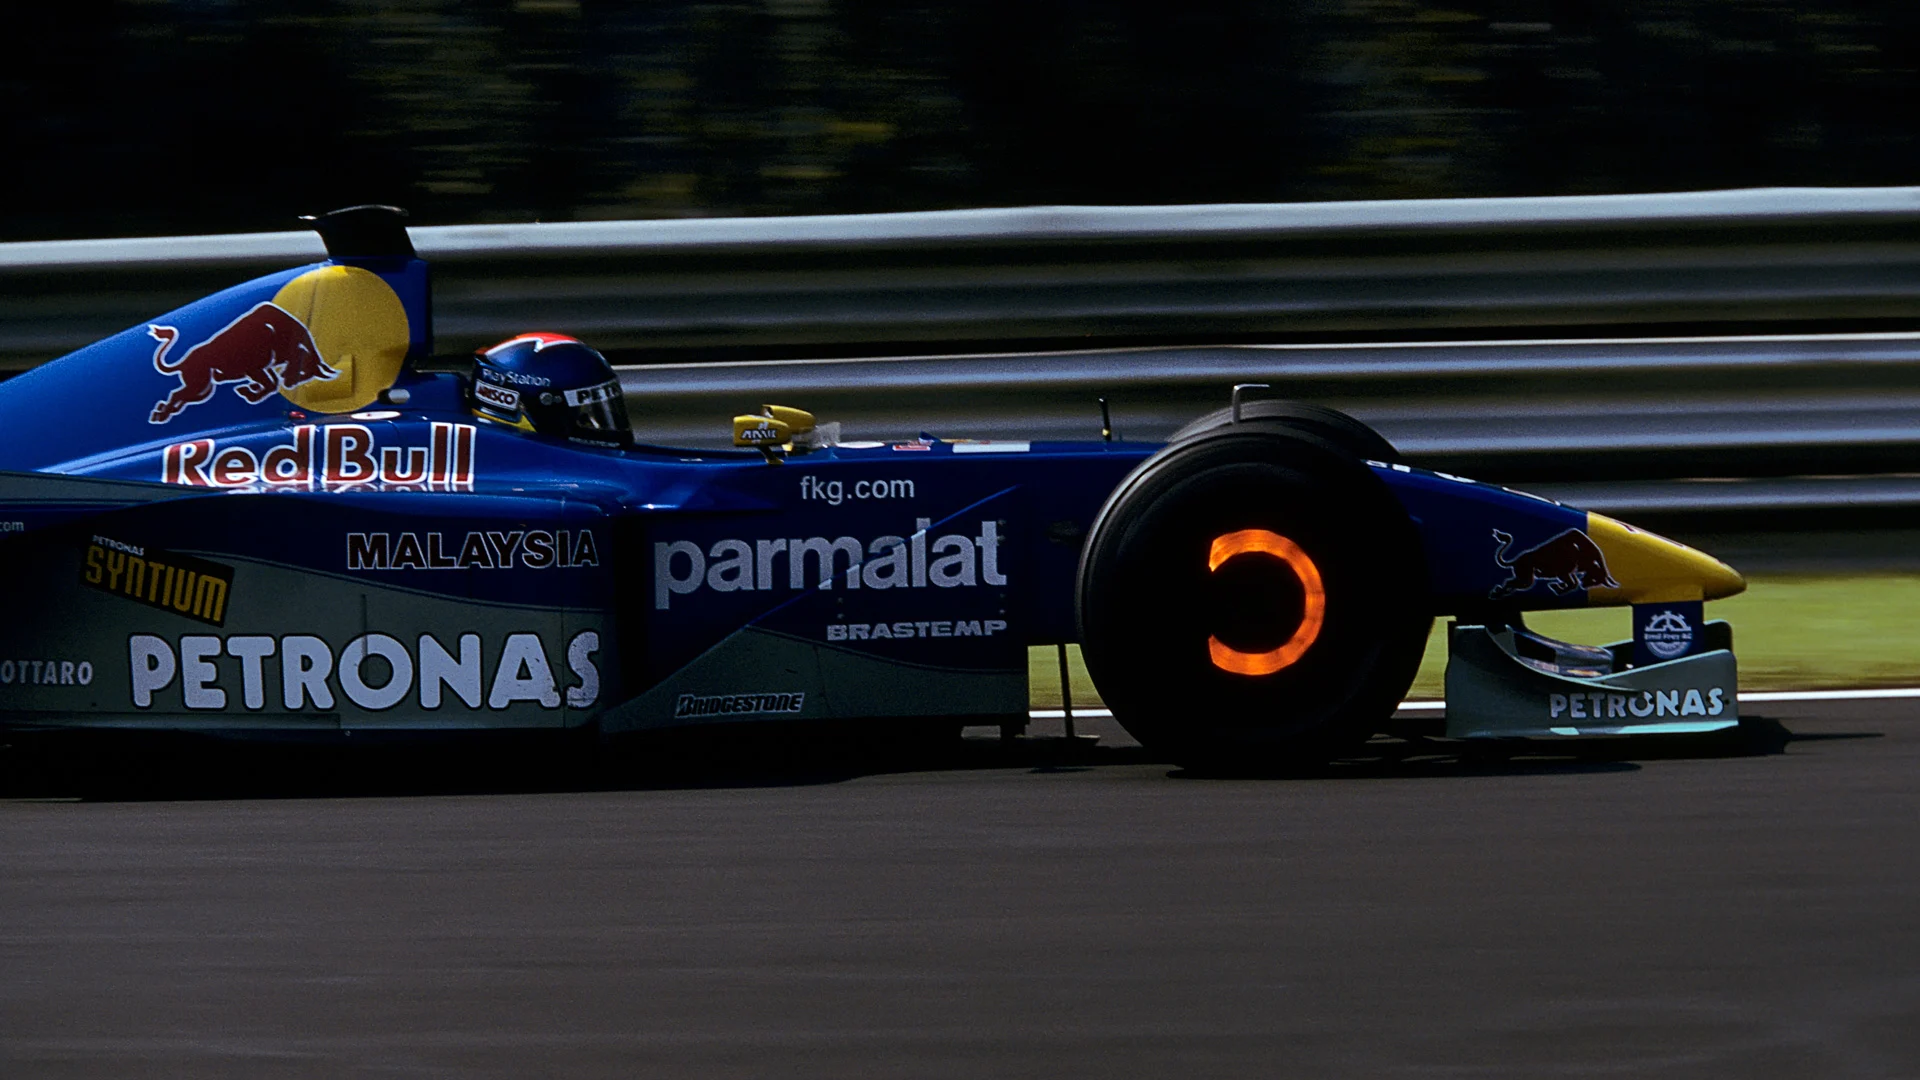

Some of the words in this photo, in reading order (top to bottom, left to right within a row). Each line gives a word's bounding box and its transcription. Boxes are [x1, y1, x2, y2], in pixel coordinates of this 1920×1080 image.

[482, 367, 551, 388] PlayStation
[162, 423, 316, 488] Red
[319, 421, 477, 484] Bull
[800, 475, 916, 506] fkg.com
[92, 534, 145, 557] PETRONAS
[346, 529, 599, 570] MALAYSIA
[653, 517, 1008, 610] parmalat
[84, 545, 229, 623] SYNTIUM
[826, 619, 1008, 642] BRASTEMP
[0, 659, 94, 686] OTTARO
[127, 629, 600, 711] PETRONAS
[676, 693, 804, 718] BRIDGESTONE
[1550, 687, 1725, 719] PETRONAS
